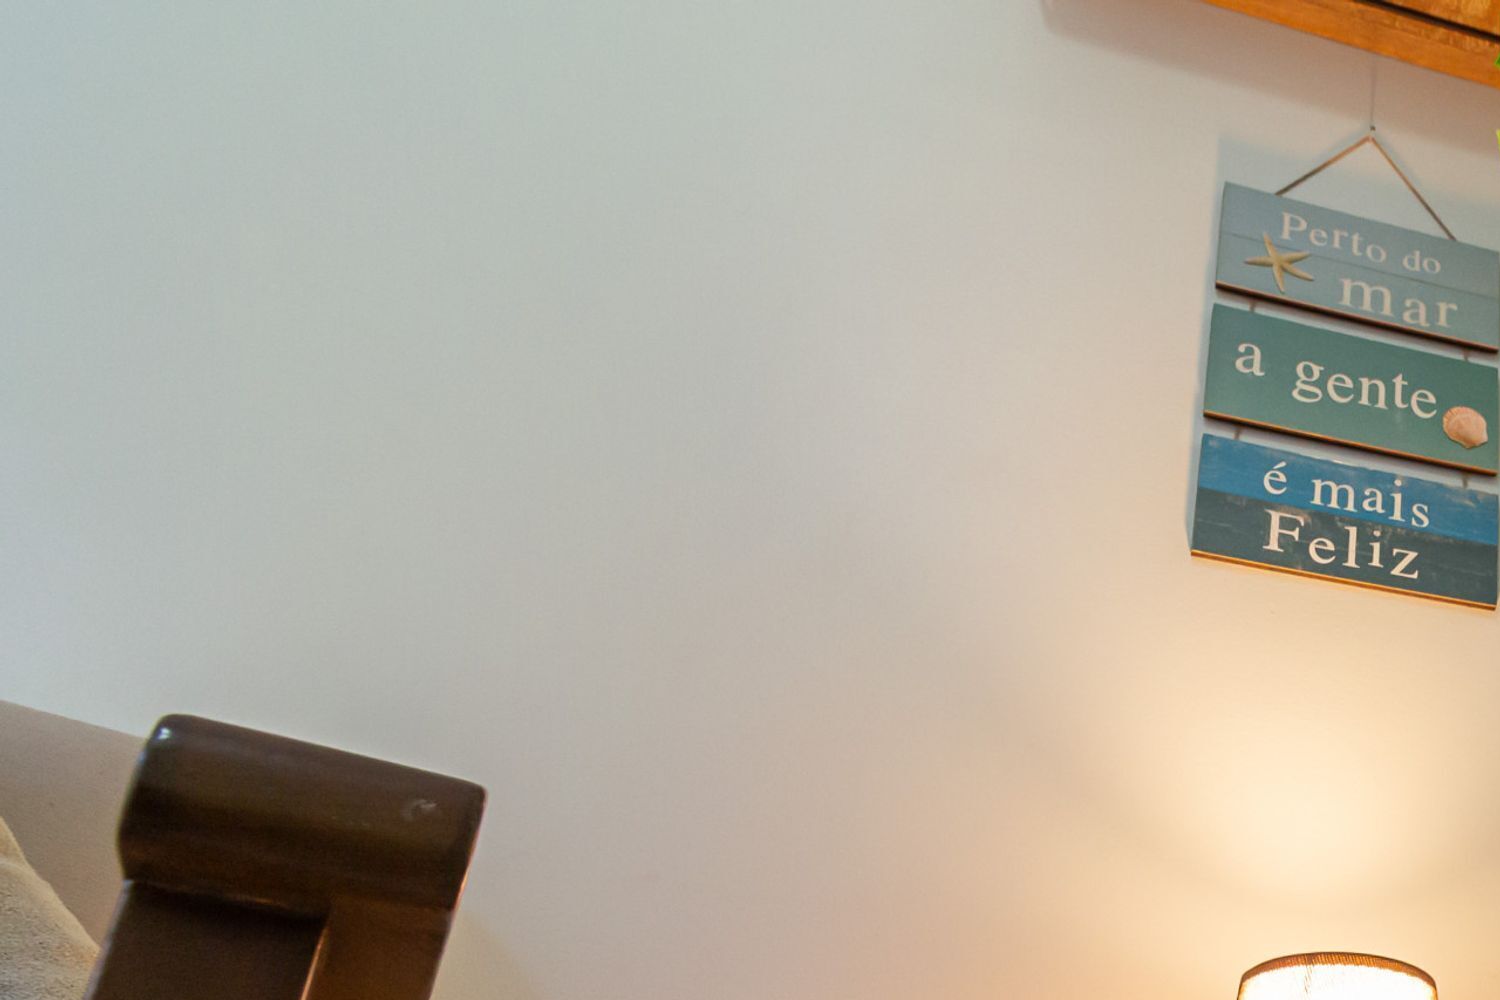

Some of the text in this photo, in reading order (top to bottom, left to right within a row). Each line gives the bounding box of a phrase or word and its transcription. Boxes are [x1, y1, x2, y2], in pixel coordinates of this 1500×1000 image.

[1280, 211, 1442, 275] Perto do
[1340, 276, 1459, 329] mar
[1234, 341, 1437, 419] a gente
[1262, 461, 1430, 528] é mais
[1262, 509, 1420, 580] Feliz
